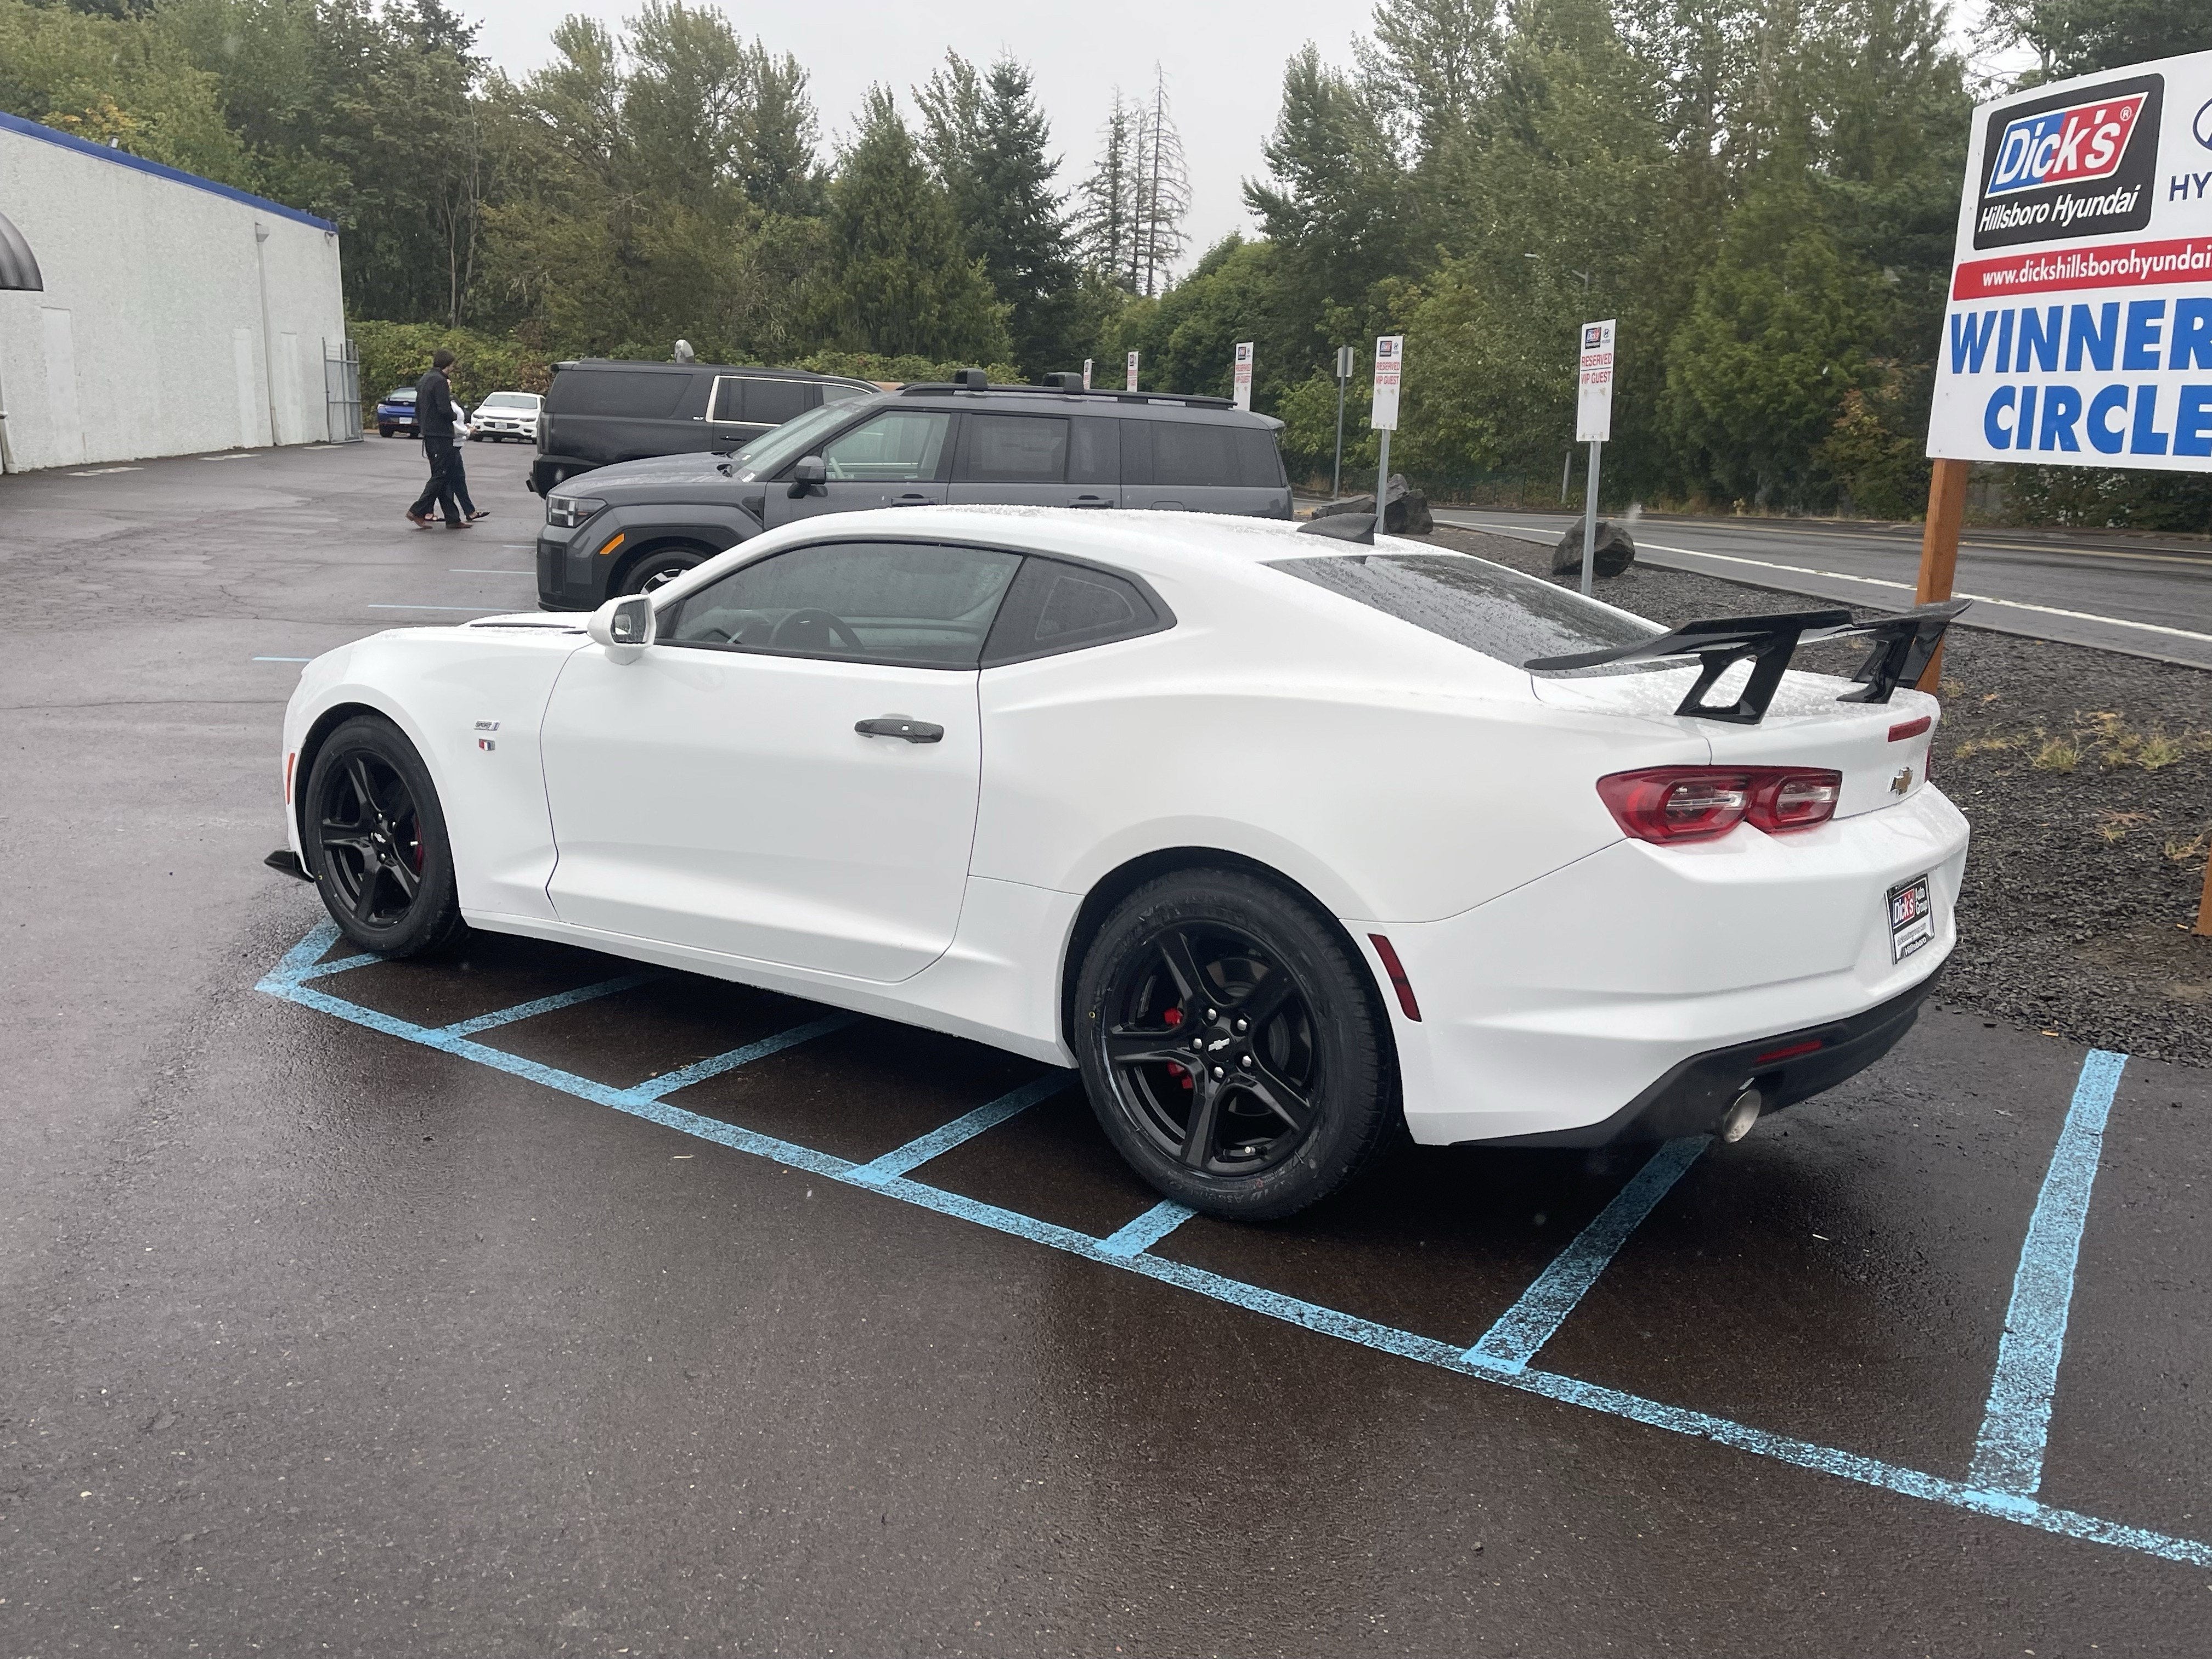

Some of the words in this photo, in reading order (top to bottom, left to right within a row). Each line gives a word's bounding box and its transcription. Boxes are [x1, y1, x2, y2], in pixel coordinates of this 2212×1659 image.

[1978, 202, 2050, 233] Hillsboro
[2051, 184, 2141, 227] Hyundai
[1582, 353, 1612, 367] RESERVED
[1951, 297, 2212, 374] WINNER
[1581, 374, 1590, 384] VIP
[1592, 371, 1611, 383] GUEST
[1984, 384, 2212, 456] CIRCLE
